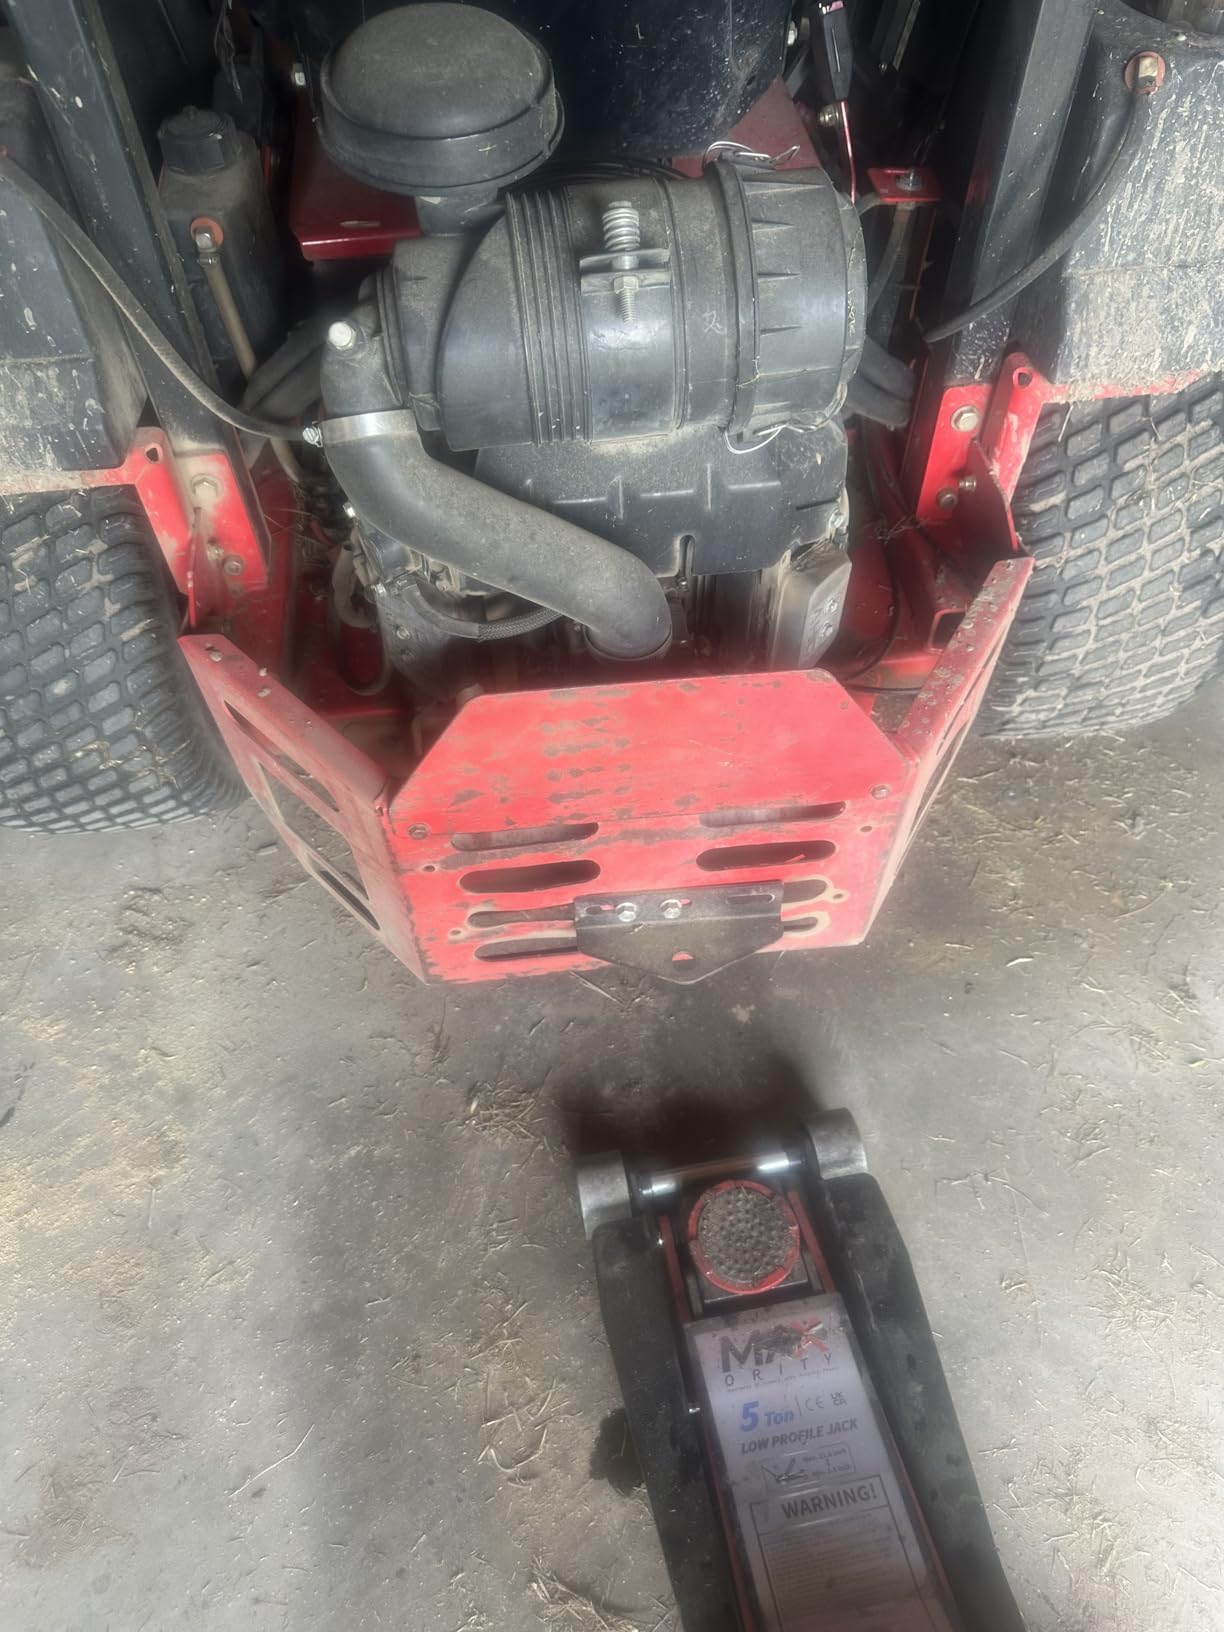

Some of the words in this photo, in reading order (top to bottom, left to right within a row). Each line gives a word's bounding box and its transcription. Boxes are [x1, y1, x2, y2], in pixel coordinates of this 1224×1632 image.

[725, 1352, 832, 1386] ORITY
[740, 1400, 760, 1432] 5
[764, 1410, 794, 1427] Ton
[741, 1438, 770, 1456] LOW
[771, 1425, 824, 1448] PROFILE
[826, 1418, 858, 1435] JACK
[780, 1483, 877, 1520] WARNING!
